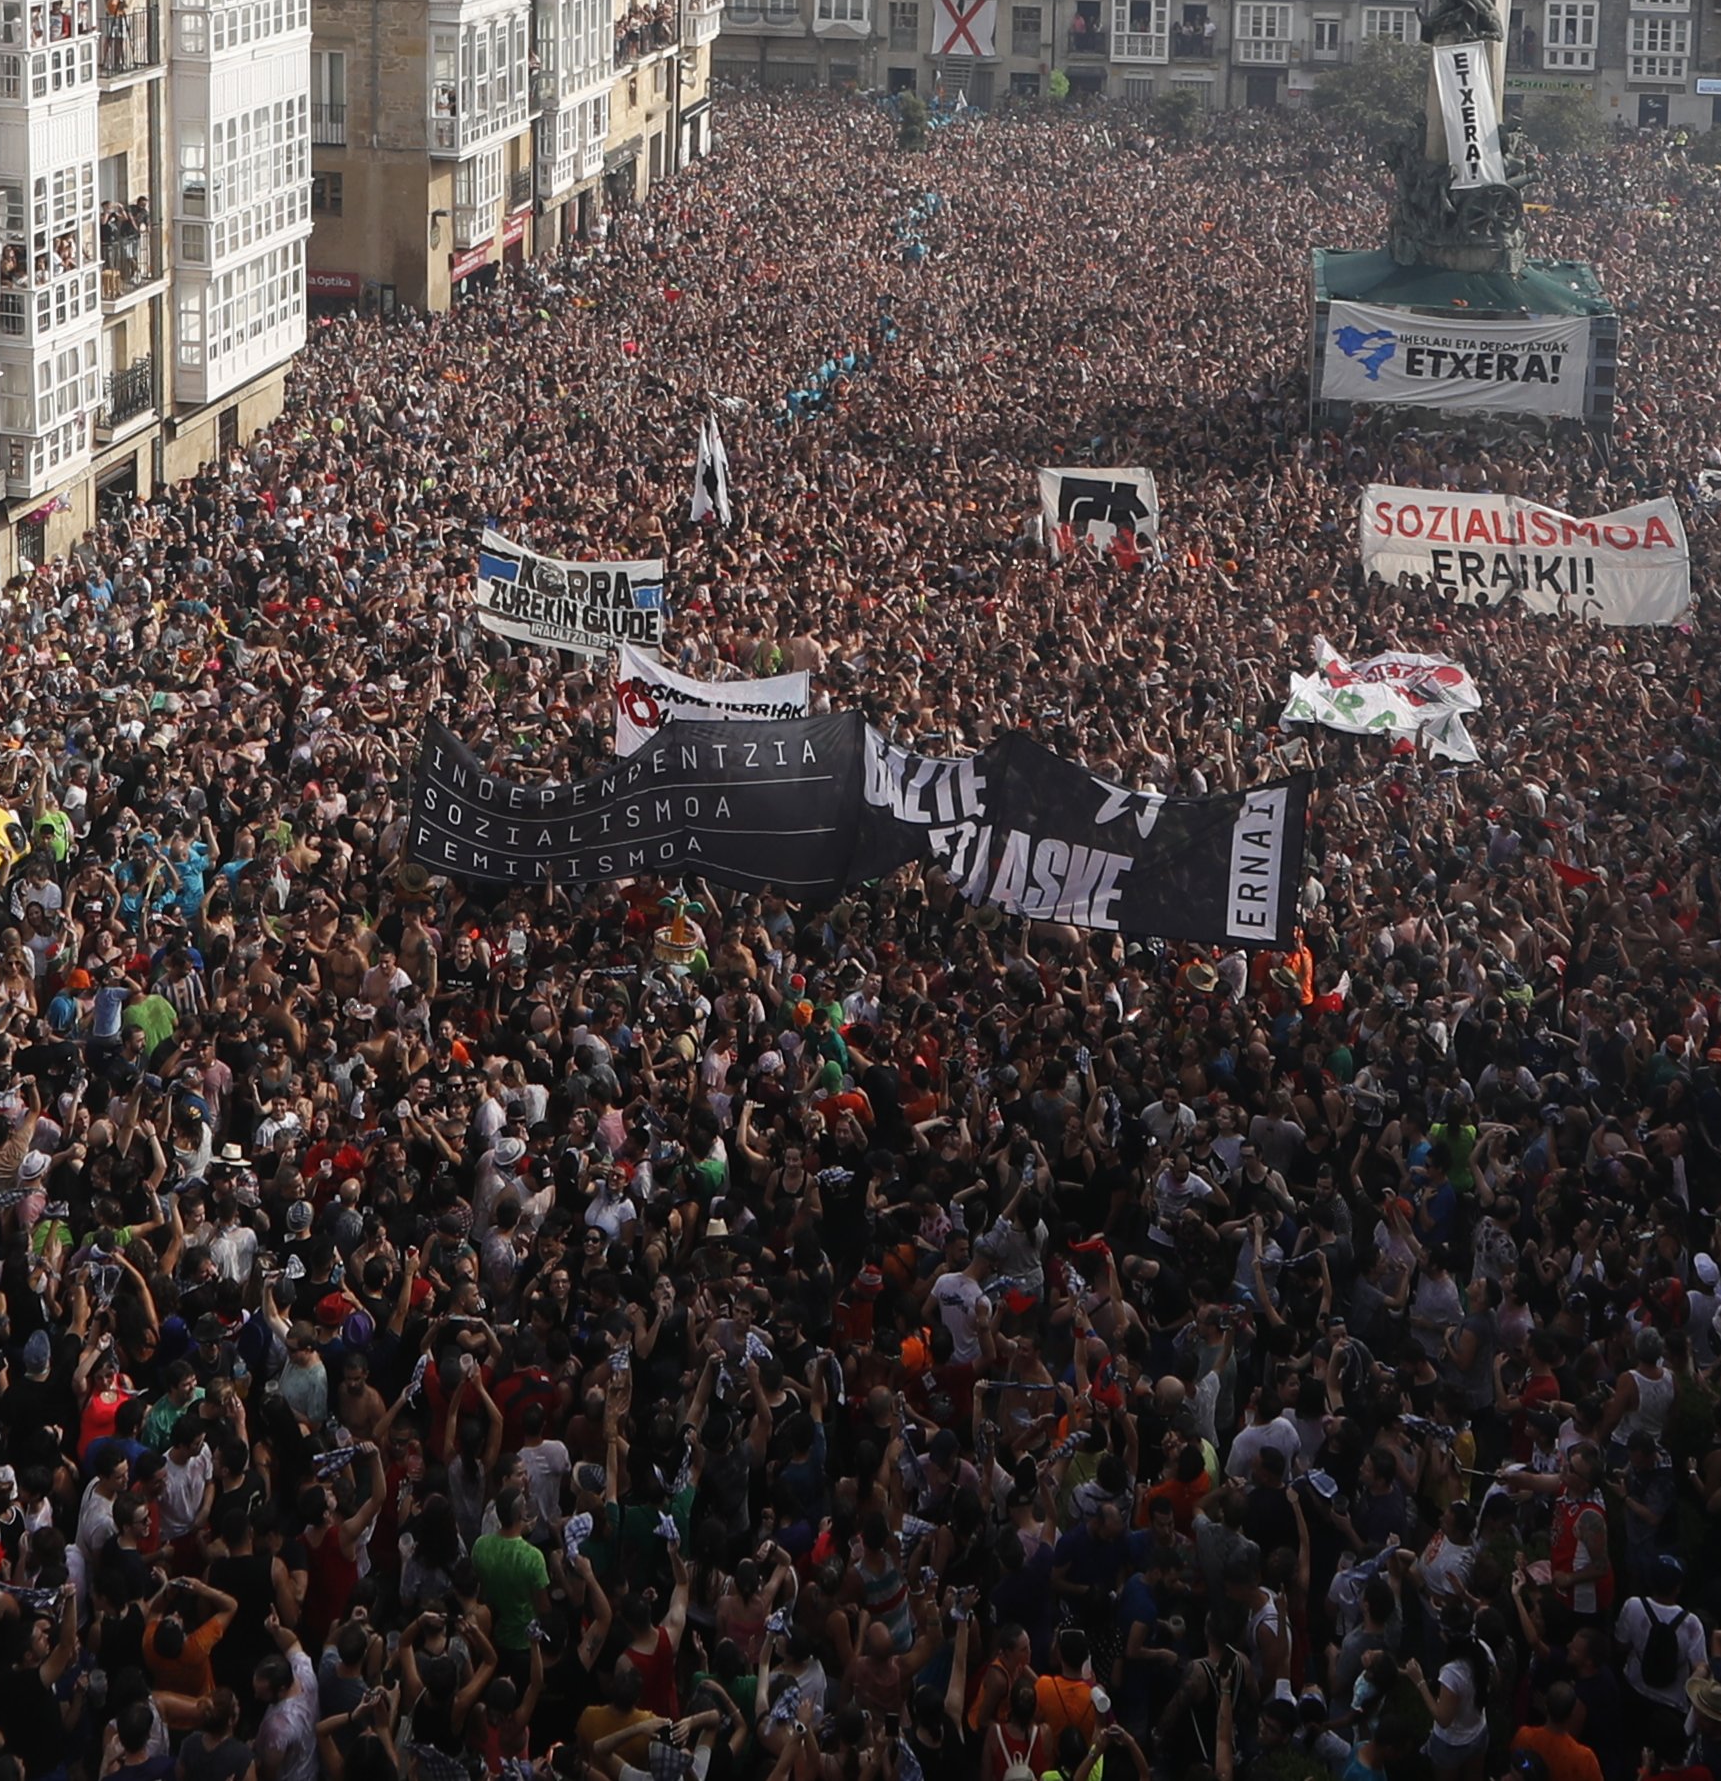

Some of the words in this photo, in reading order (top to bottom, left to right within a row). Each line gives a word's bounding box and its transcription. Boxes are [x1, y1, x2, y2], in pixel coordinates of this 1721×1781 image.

[1453, 52, 1480, 180] ETXERA!
[317, 275, 352, 287] Optika
[1400, 334, 1452, 349] IHESLARI
[1456, 339, 1477, 350] ETA
[1480, 341, 1570, 354] DEPORTATUAK
[1405, 347, 1562, 385] ETXERA!
[1373, 501, 1676, 551] SOZIALISMOA
[518, 554, 634, 610] KRRA
[1431, 548, 1595, 595] ERAIKI!
[489, 577, 579, 629] ZUREKIN
[582, 604, 659, 643] GAUDE
[431, 739, 817, 810] INDEPENDENTZIA
[423, 787, 731, 847] SOZIALISMOA
[417, 826, 704, 878] FEMINISMOA
[987, 828, 1135, 931] ASKE
[1235, 802, 1275, 930] ERNAI
